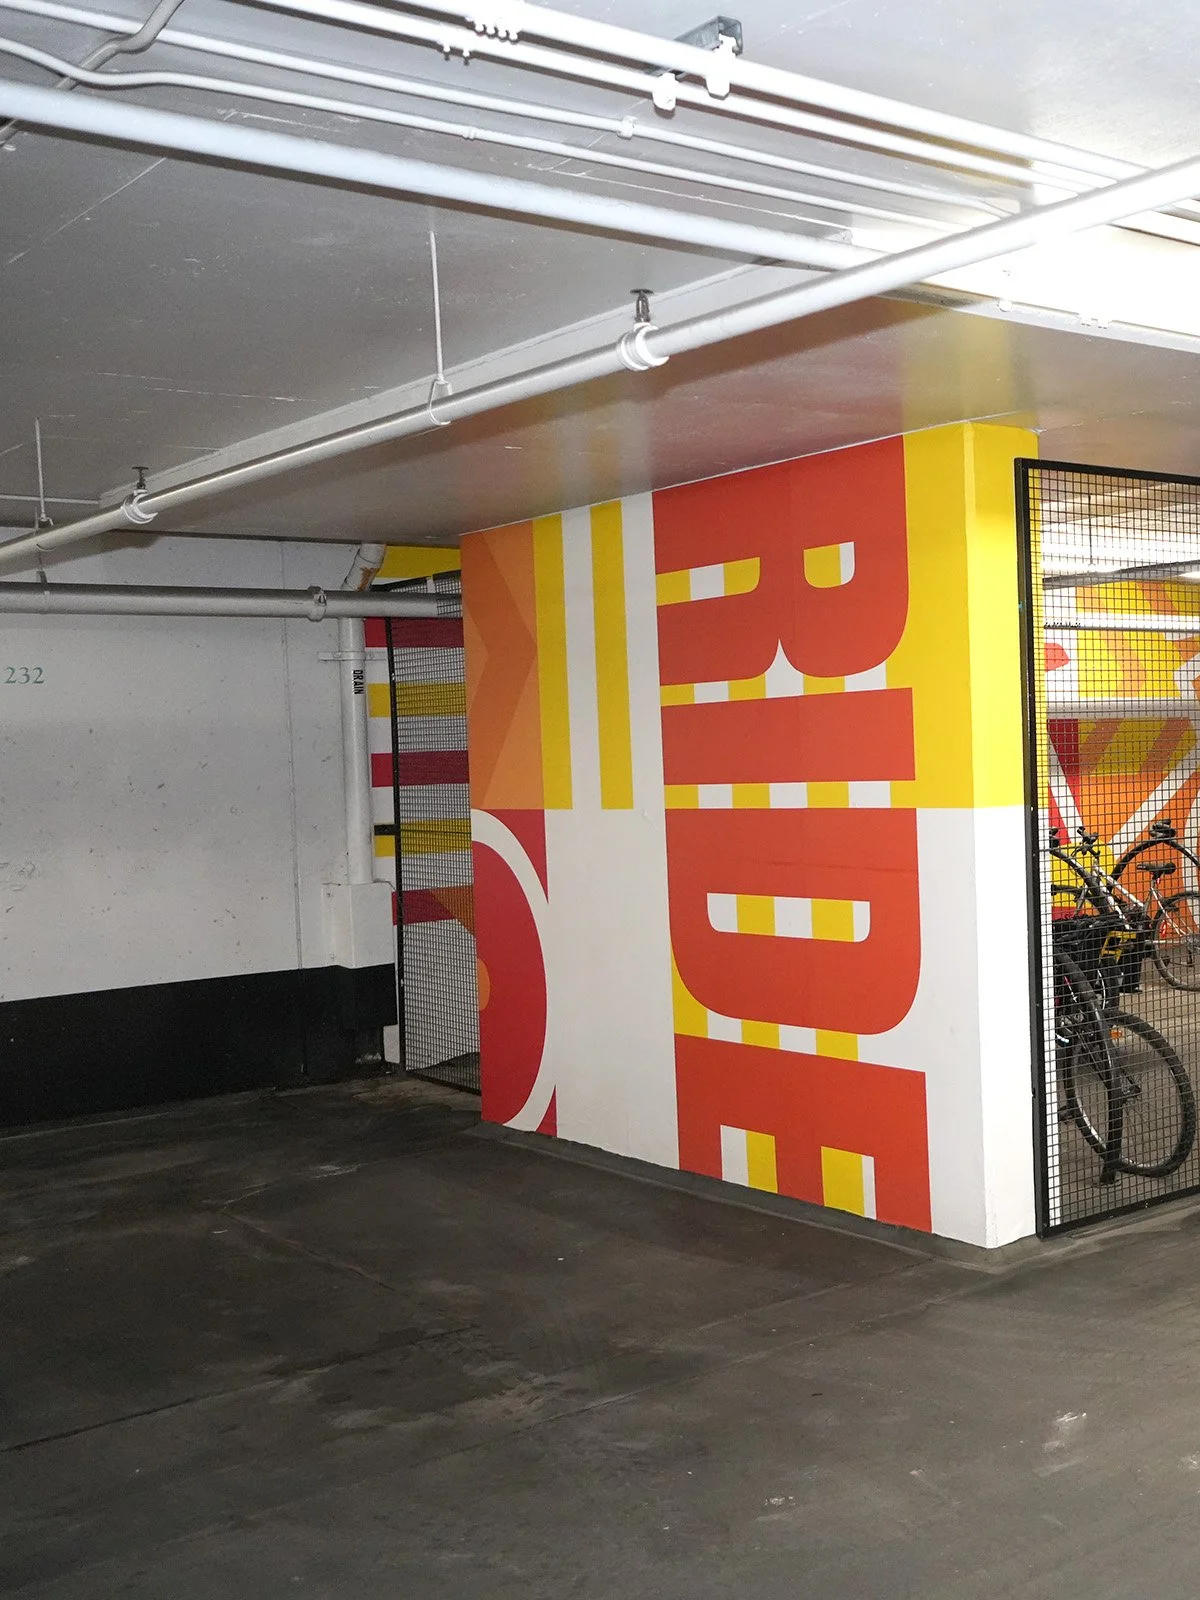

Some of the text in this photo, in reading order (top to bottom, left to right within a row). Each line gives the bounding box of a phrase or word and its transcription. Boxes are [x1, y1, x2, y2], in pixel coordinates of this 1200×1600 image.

[5, 666, 45, 685] 232
[352, 669, 364, 695] DRAIN
[652, 436, 932, 1233] RIDE
